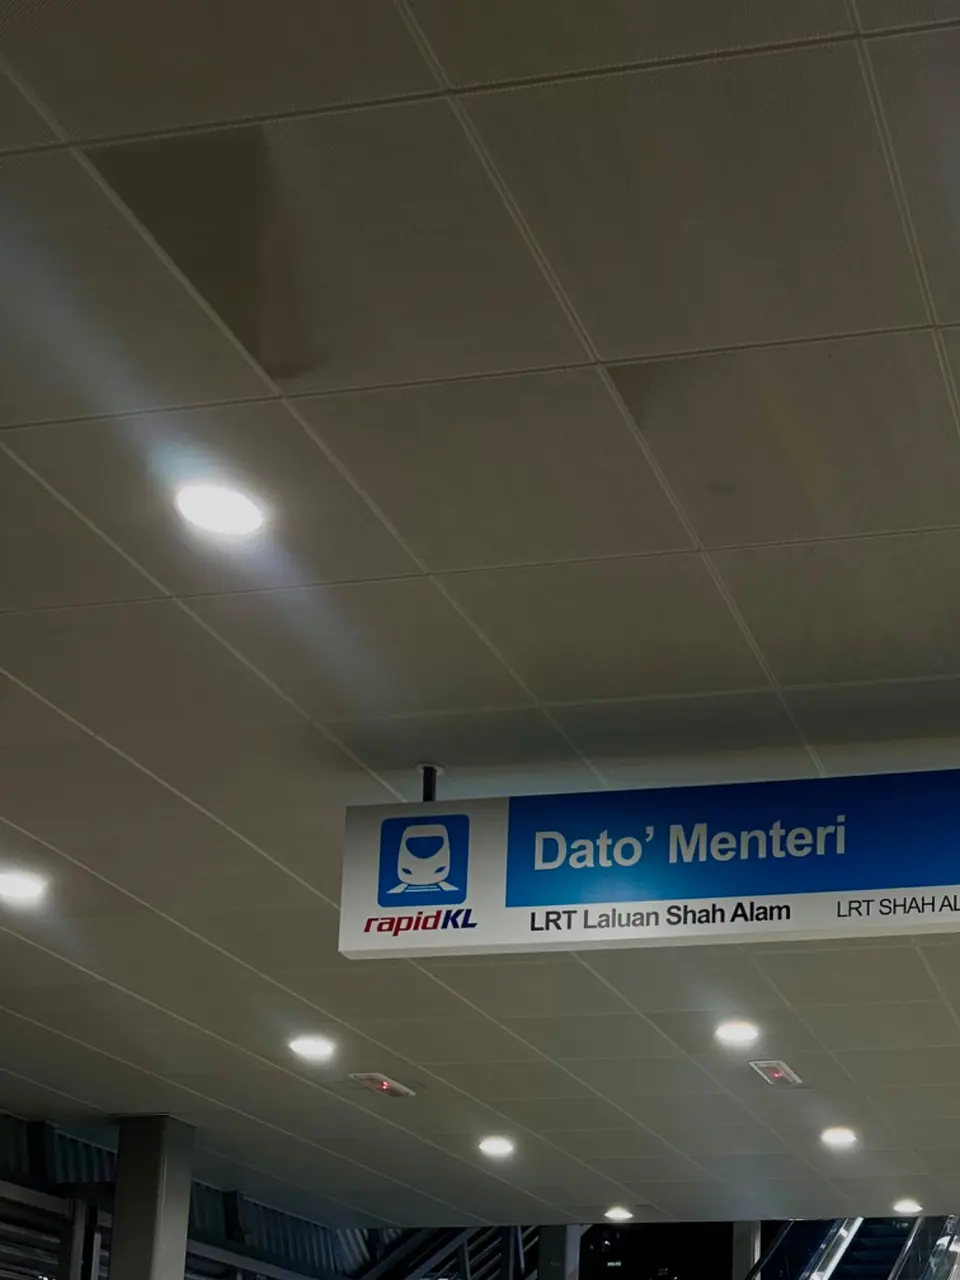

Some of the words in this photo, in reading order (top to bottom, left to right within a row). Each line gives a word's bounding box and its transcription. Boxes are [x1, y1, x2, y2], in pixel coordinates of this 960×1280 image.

[669, 815, 846, 863] Menteri
[530, 910, 577, 931] LRT
[583, 907, 659, 930] Laluan
[666, 904, 726, 926] Shah
[730, 901, 791, 922] Alam
[836, 900, 874, 918] LRT
[878, 896, 936, 915] SHAH
[363, 908, 478, 936] rapidKL
